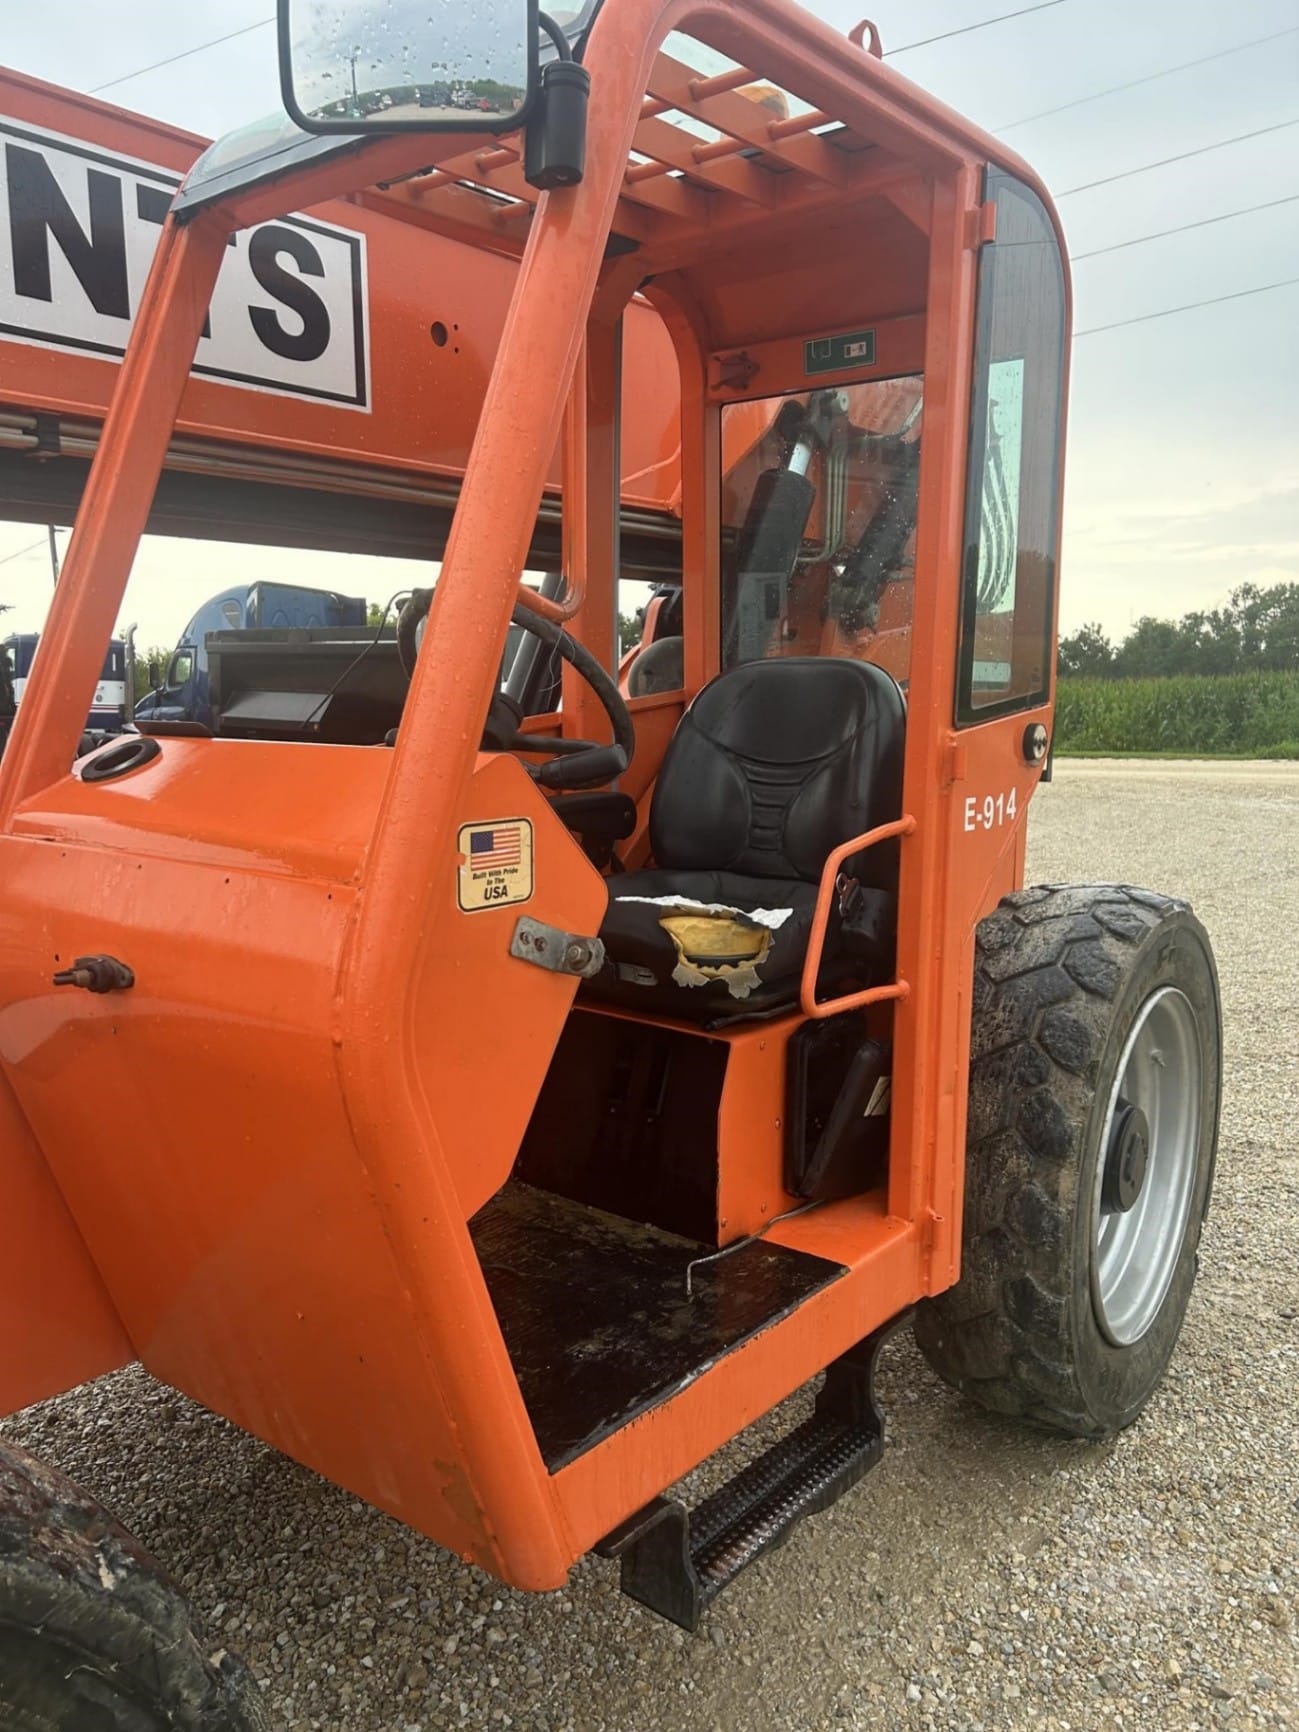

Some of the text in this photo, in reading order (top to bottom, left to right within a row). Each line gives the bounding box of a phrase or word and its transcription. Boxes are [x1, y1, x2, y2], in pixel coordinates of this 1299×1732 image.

[4, 142, 331, 362] NS
[964, 786, 1017, 832] E-914
[472, 872, 487, 880] Built
[484, 885, 508, 900] USA
